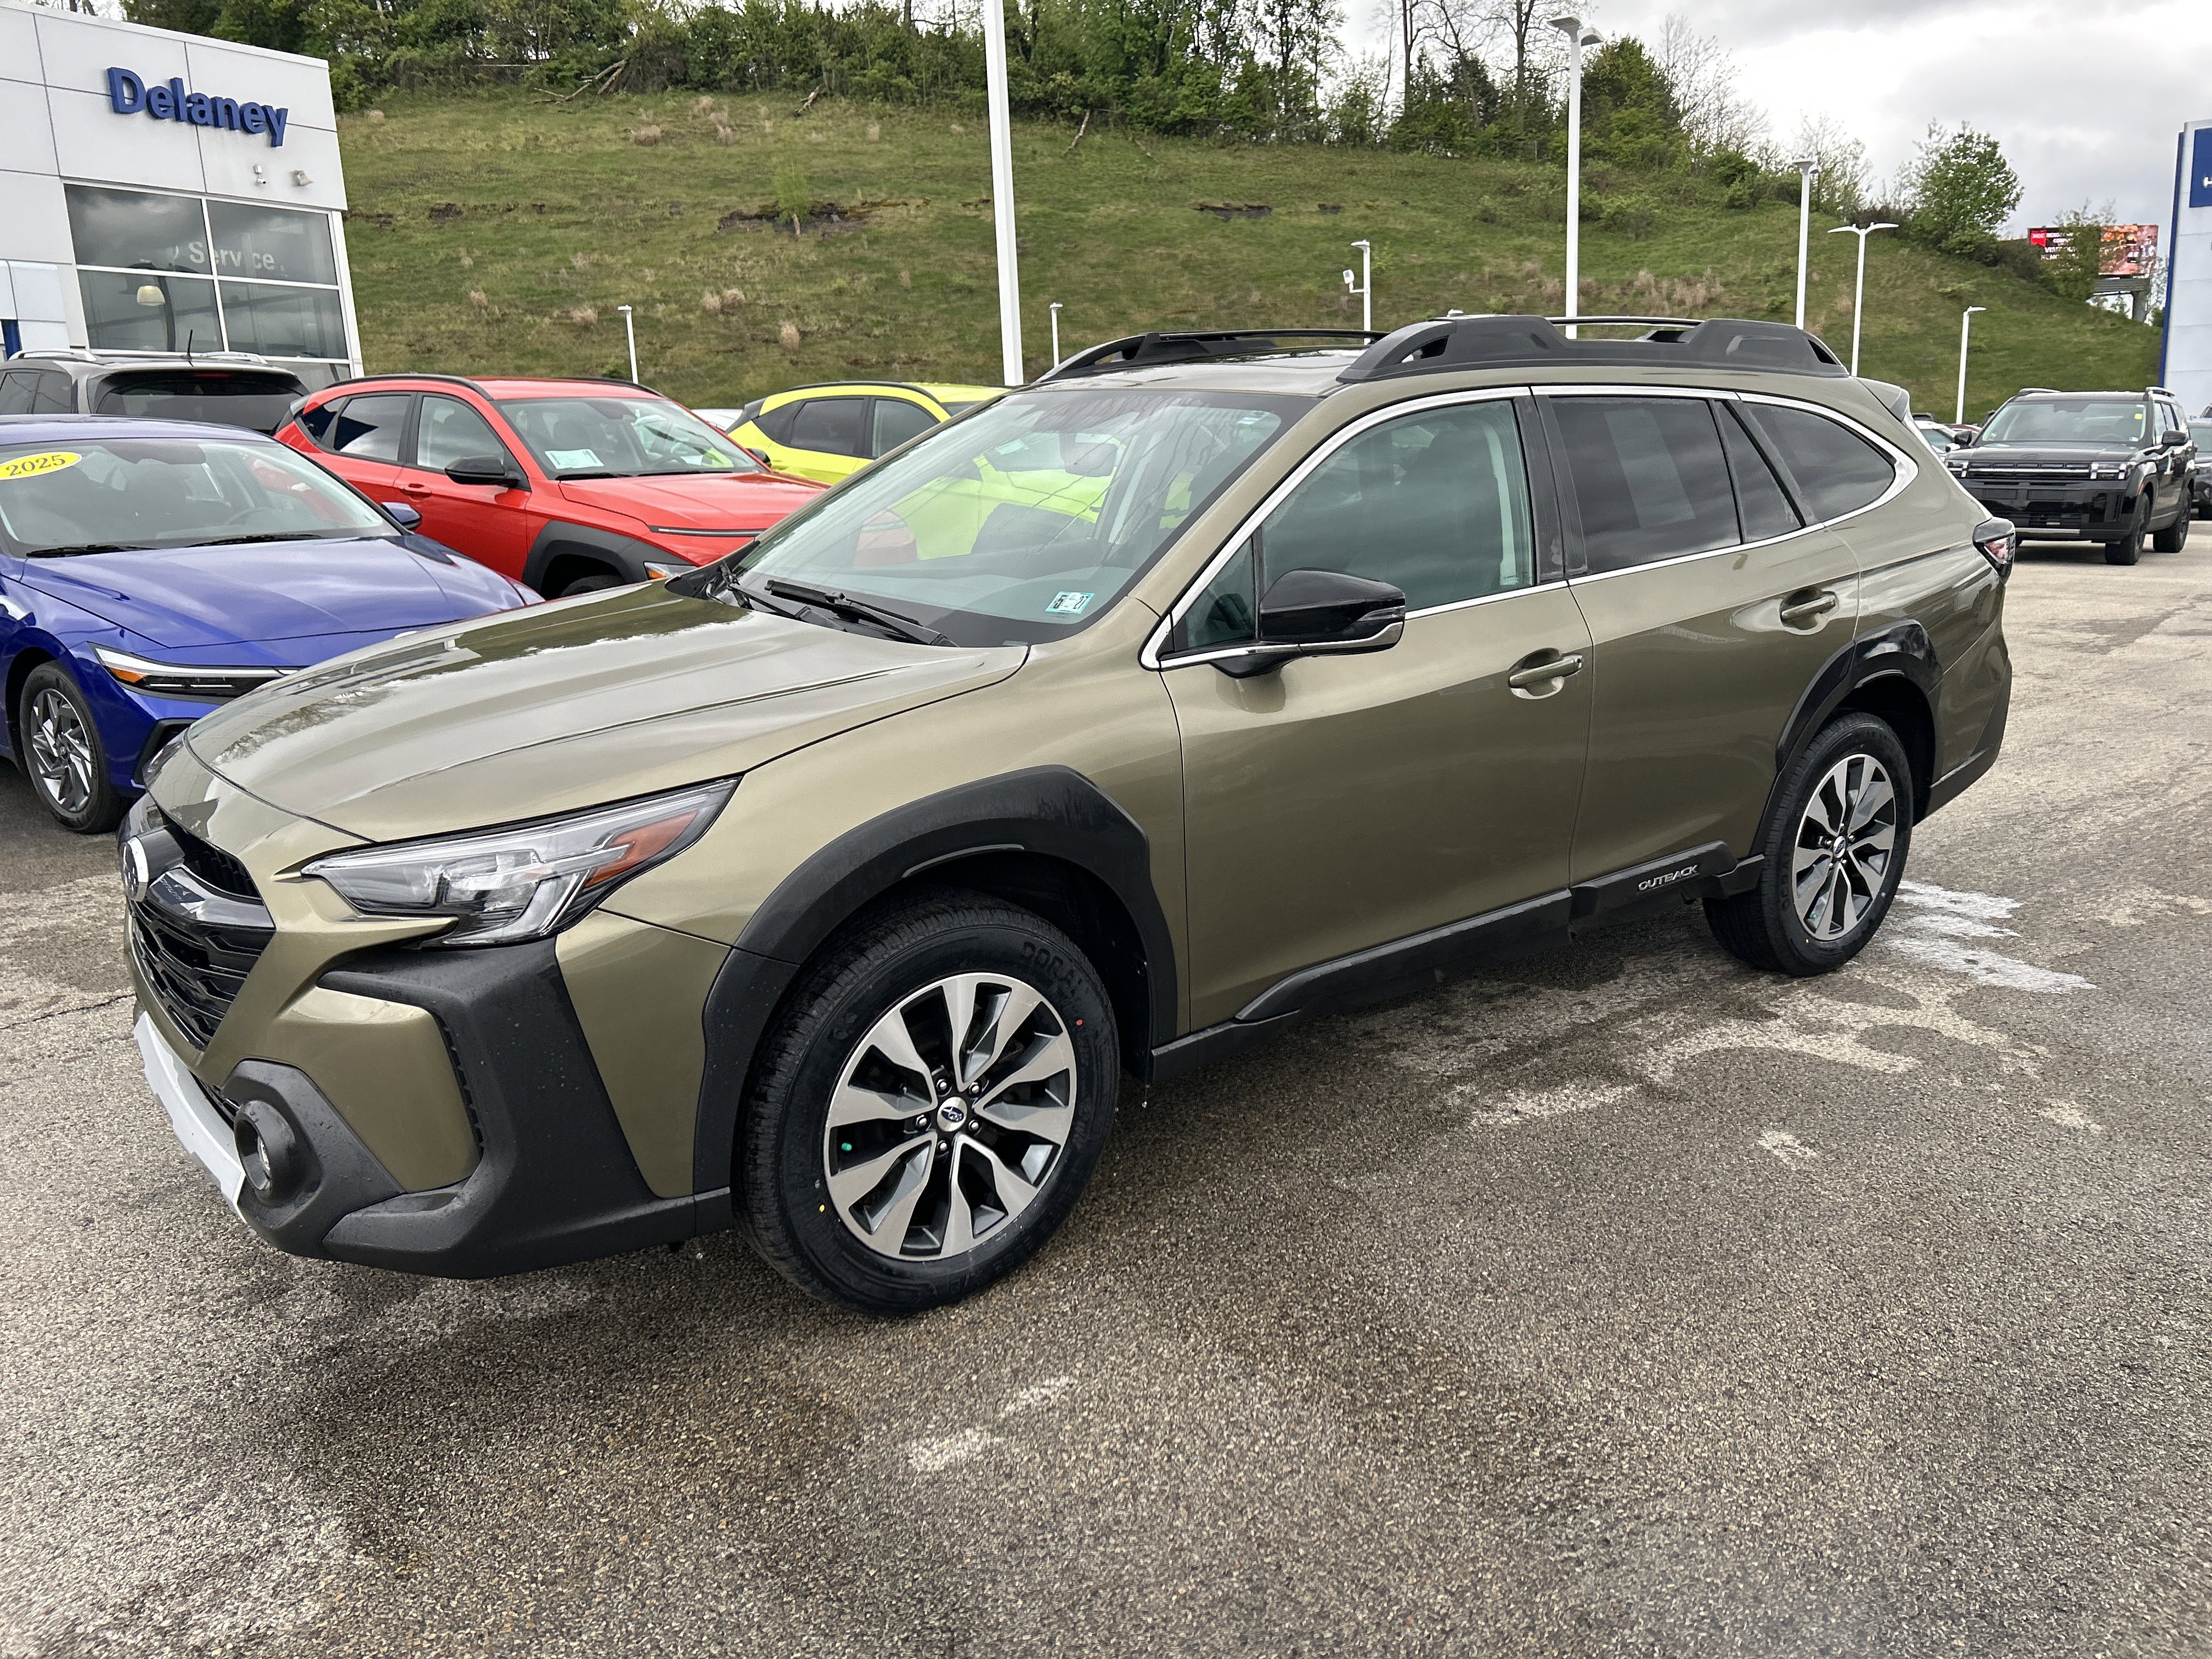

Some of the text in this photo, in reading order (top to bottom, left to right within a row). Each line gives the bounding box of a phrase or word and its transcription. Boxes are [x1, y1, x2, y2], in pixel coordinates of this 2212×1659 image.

[107, 66, 289, 148] Delaney
[188, 241, 275, 270] Srvce
[5, 454, 66, 477] 2025
[1073, 595, 1089, 610] 27
[1638, 864, 1698, 891] OUTBACK
